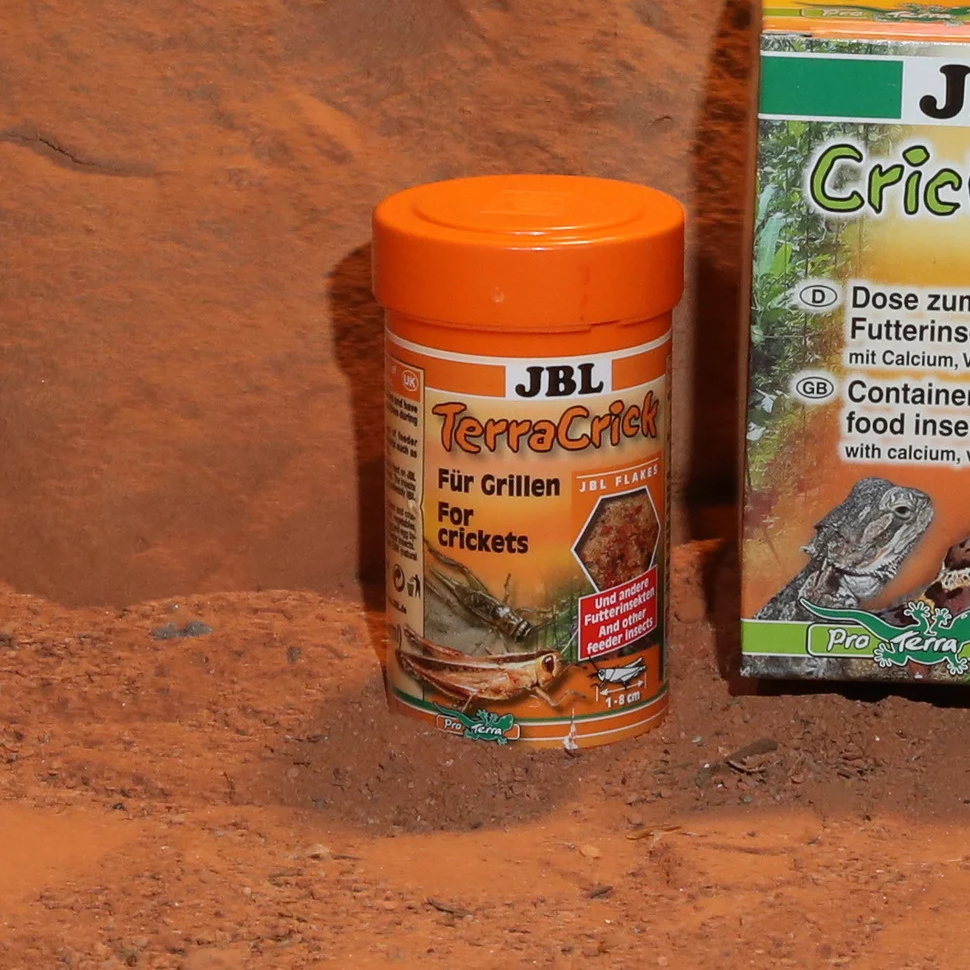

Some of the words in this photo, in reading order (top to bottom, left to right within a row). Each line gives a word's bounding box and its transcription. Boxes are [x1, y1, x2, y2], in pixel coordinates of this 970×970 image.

[822, 8, 864, 18] Pro
[811, 288, 826, 305] D
[851, 286, 919, 312] Dose
[848, 349, 877, 366] mit
[881, 350, 959, 371] Calcium,
[403, 373, 417, 389] UK
[515, 363, 604, 398] JBL
[802, 380, 828, 397] GB
[432, 390, 660, 454] TerraCrick
[846, 411, 905, 436] food
[845, 443, 881, 461] with
[887, 444, 961, 464] calcium,
[438, 468, 474, 493] Für
[480, 473, 561, 498] Grillen
[579, 479, 607, 493] JBL
[615, 464, 659, 487] FLAKES
[438, 502, 474, 526] For
[437, 527, 529, 555] crickets
[595, 592, 617, 610] Und
[619, 577, 650, 601] andere
[584, 587, 656, 627] Futterinsekten
[598, 621, 620, 638] And
[621, 608, 647, 629] other
[586, 633, 623, 655] feeder
[625, 617, 654, 641] insects
[827, 628, 870, 652] Pro
[890, 630, 958, 653] Terra
[626, 690, 641, 704] cm
[444, 718, 462, 730] Pro
[471, 723, 502, 735] Terra
